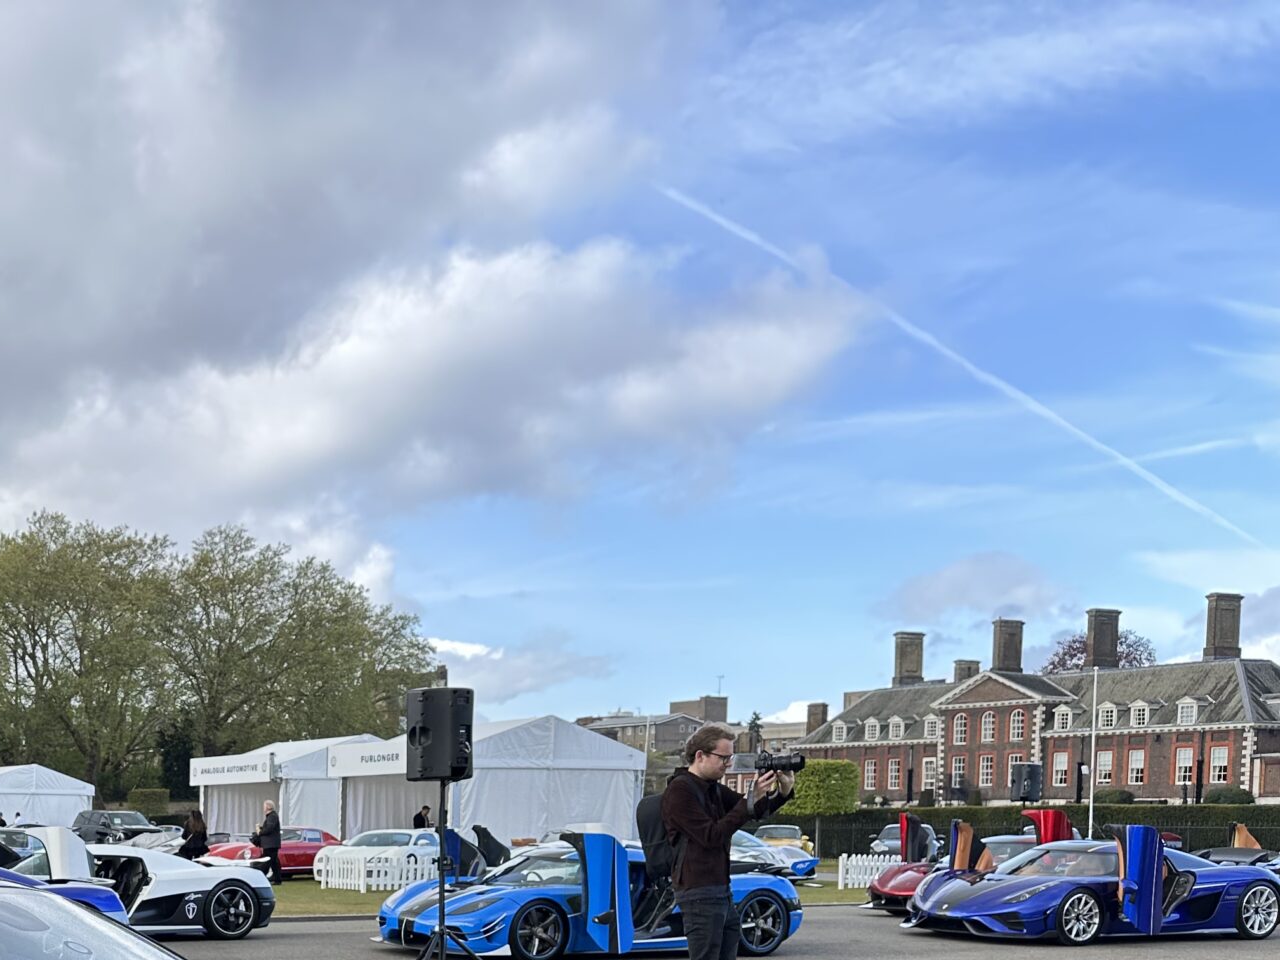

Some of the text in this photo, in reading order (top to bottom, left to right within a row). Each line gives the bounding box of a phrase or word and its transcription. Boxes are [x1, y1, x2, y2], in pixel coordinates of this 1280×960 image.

[360, 753, 400, 764] FURLONGER
[200, 764, 258, 775] ANALOGUE AUTOMOTIVE
